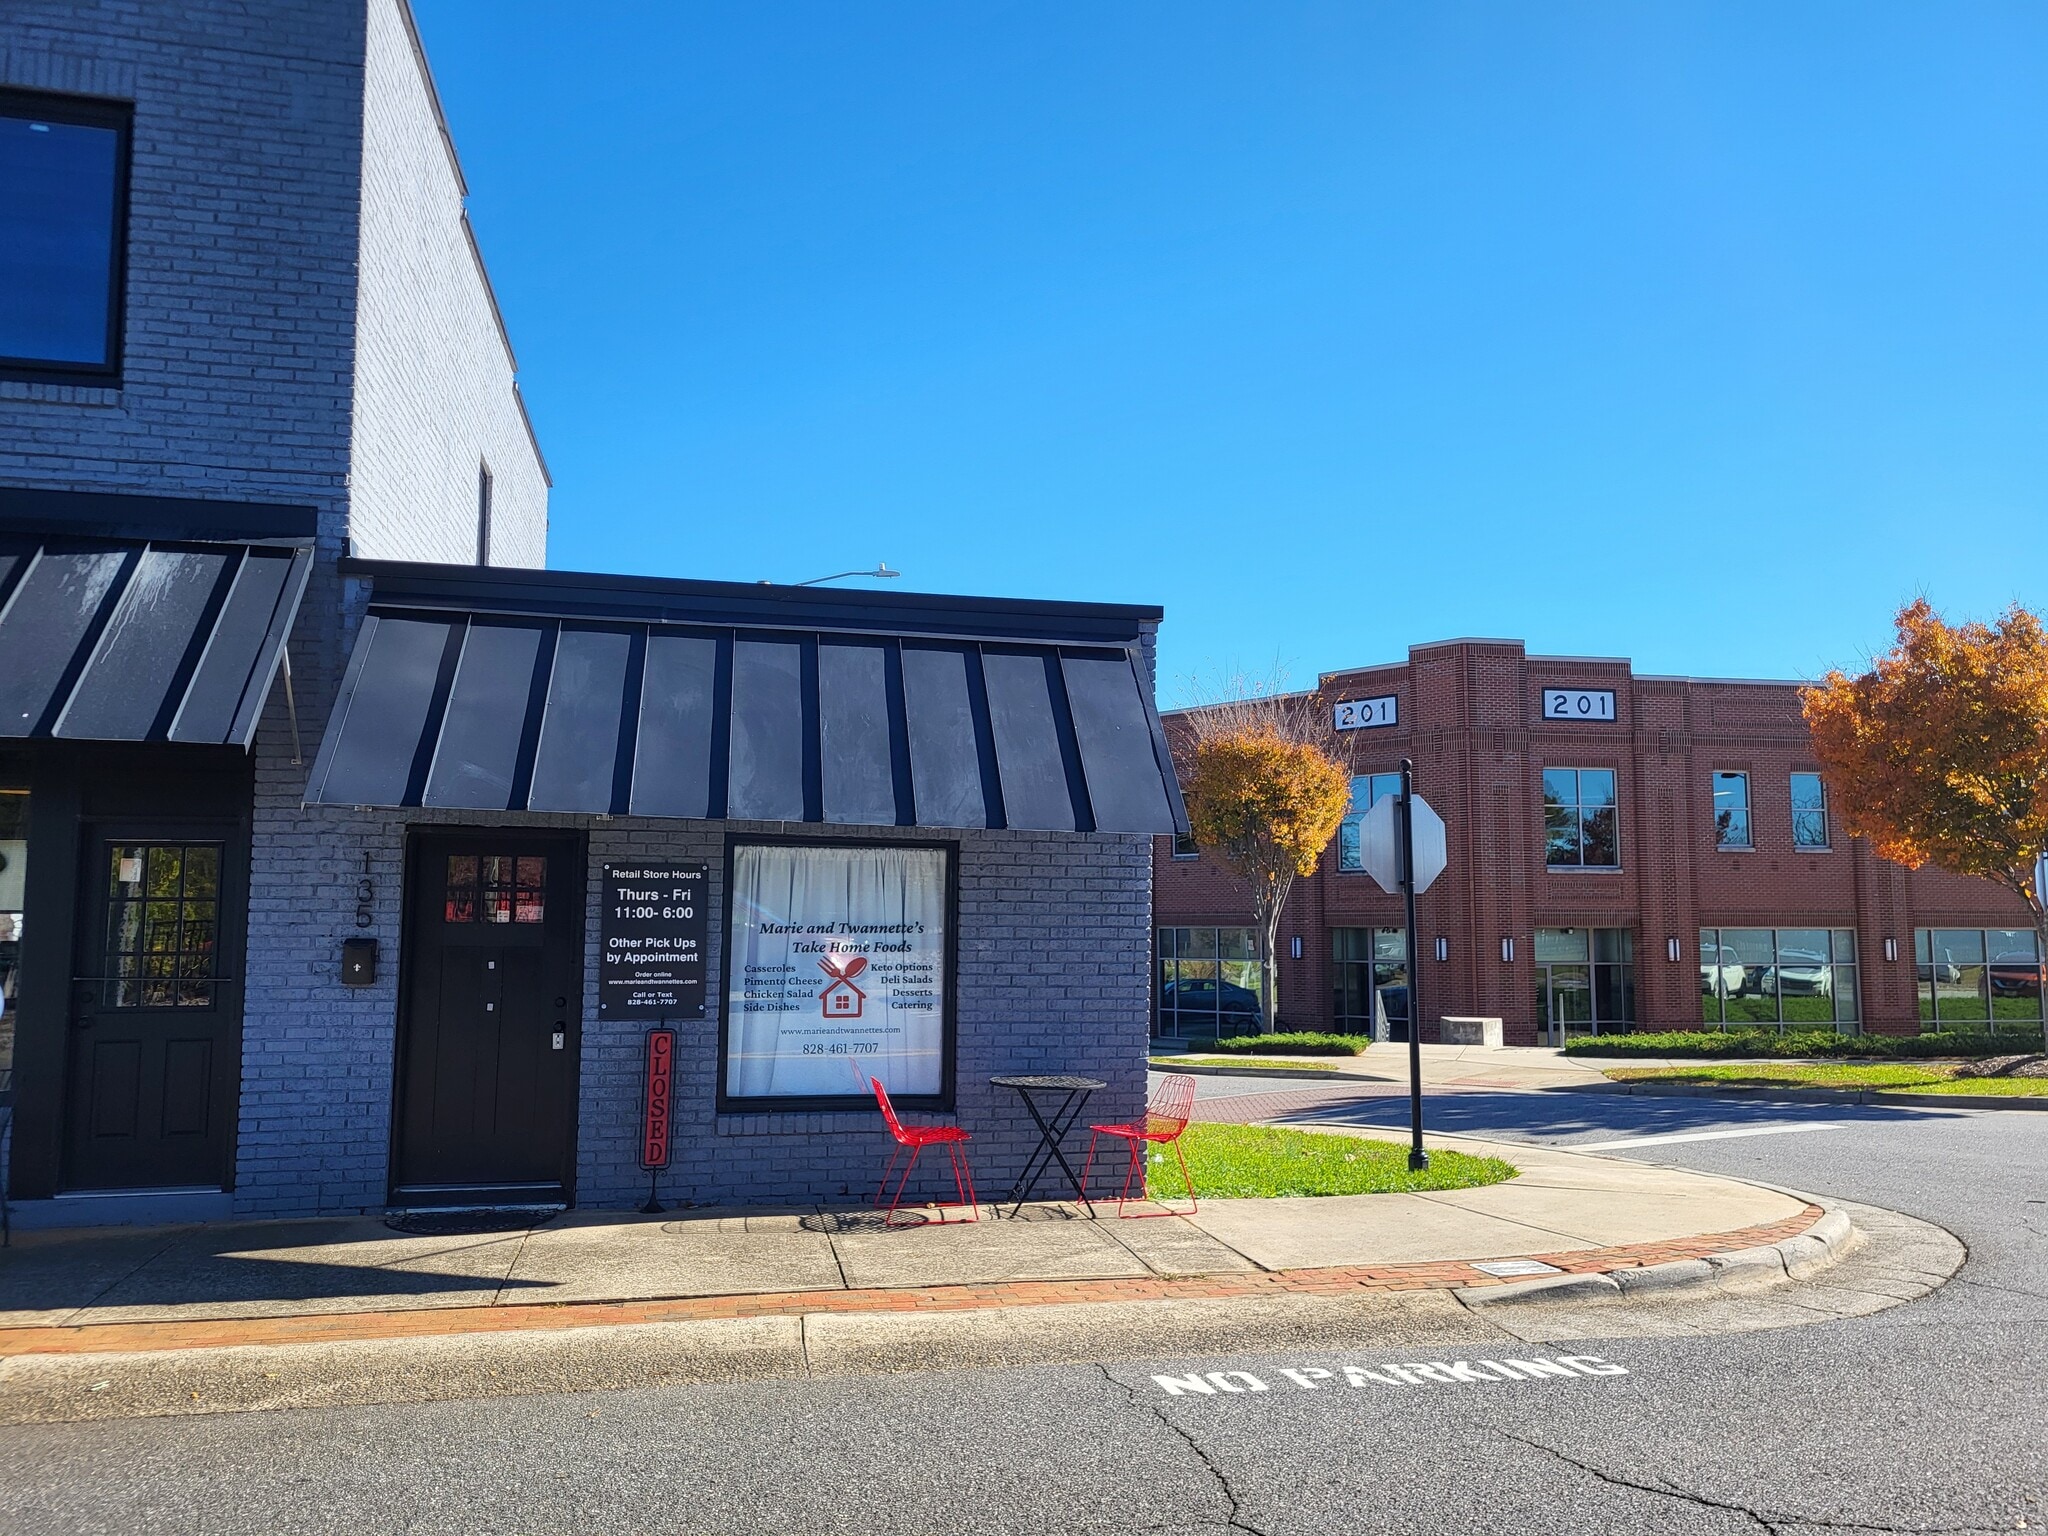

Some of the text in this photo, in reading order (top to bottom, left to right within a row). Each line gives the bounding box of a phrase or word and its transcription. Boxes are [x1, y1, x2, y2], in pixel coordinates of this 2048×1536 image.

[1553, 694, 1606, 716] 201
[1341, 701, 1387, 726] 201
[612, 870, 702, 880] Retail Store Hours
[355, 851, 373, 928] 135
[617, 888, 659, 901] Thurs
[672, 888, 691, 901] Fri
[614, 906, 694, 919] 11:00- 6:00
[759, 921, 925, 934] Marie and Twannette's
[609, 937, 697, 950] Other Pick Ups
[792, 940, 913, 954] Take Home Foods
[606, 952, 699, 964] by Appointment
[744, 964, 796, 973] Casseroles
[870, 963, 933, 974] Keto Options
[744, 976, 823, 986] Pimento Cheese
[880, 975, 933, 985] Deli Salads
[743, 990, 813, 999] Chicken Salad
[892, 988, 933, 997] Desserts
[743, 1002, 800, 1012] Side Dishes
[891, 1001, 933, 1011] Catering
[780, 1026, 901, 1036] www.marieandtwannettes.com
[802, 1042, 879, 1055] 828-461-7707
[649, 1036, 668, 1162] CLOSED
[1150, 1354, 1630, 1396] NO PARKING
